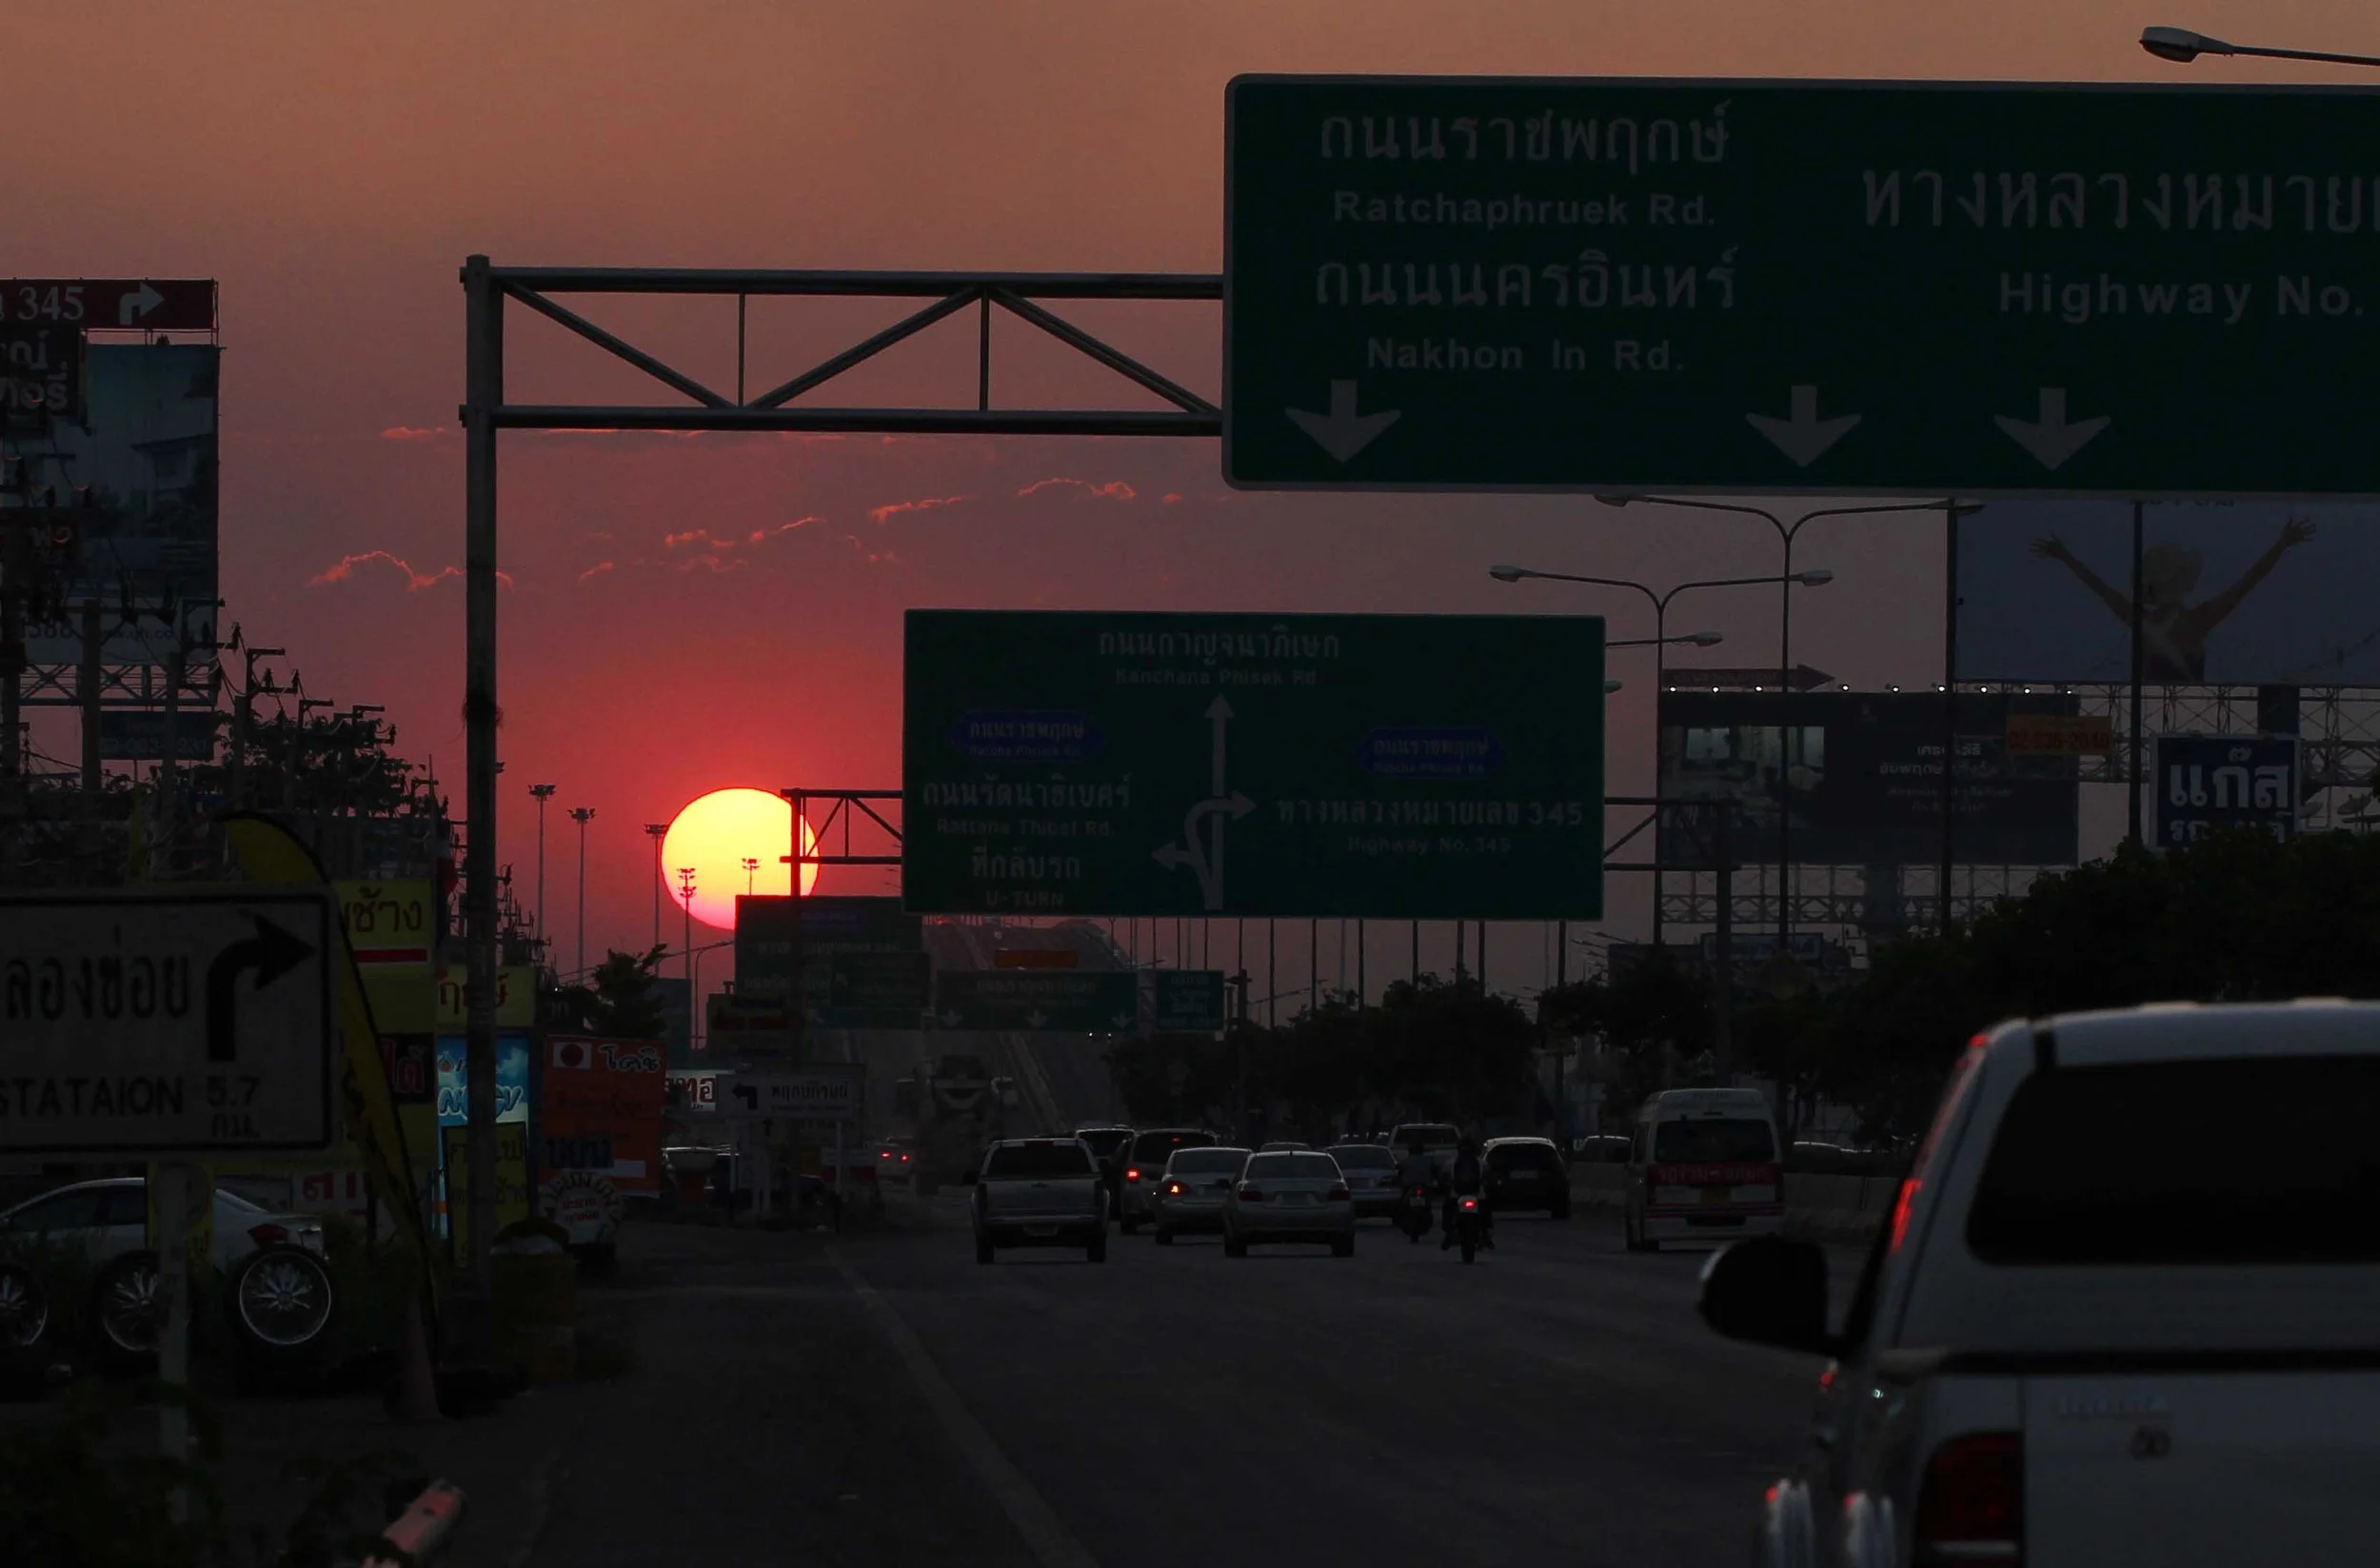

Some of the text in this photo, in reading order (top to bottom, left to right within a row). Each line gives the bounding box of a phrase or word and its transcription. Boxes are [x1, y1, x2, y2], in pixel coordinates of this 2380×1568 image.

[1319, 98, 1732, 175] ถนนราชพฤกษ์
[1334, 190, 1715, 230] Ratchaphruek Rd.
[1316, 245, 1739, 309] ถนนนครอินทร์
[17, 286, 85, 321] 345
[2000, 271, 2365, 326] Highway No.
[1367, 337, 1683, 370] Nakhon In Rd.
[1099, 624, 1341, 665] ถนนกาญจนาภิเษก
[1115, 668, 1211, 685] Kanchana
[922, 772, 1131, 808] ถนนรัตนาธิเบศร์
[2170, 746, 2290, 809] แก๊ส
[1277, 799, 1583, 825] ทางหลวงหมายเลข 345
[1347, 836, 1427, 856] Highway
[206, 1076, 261, 1106] 5.7
